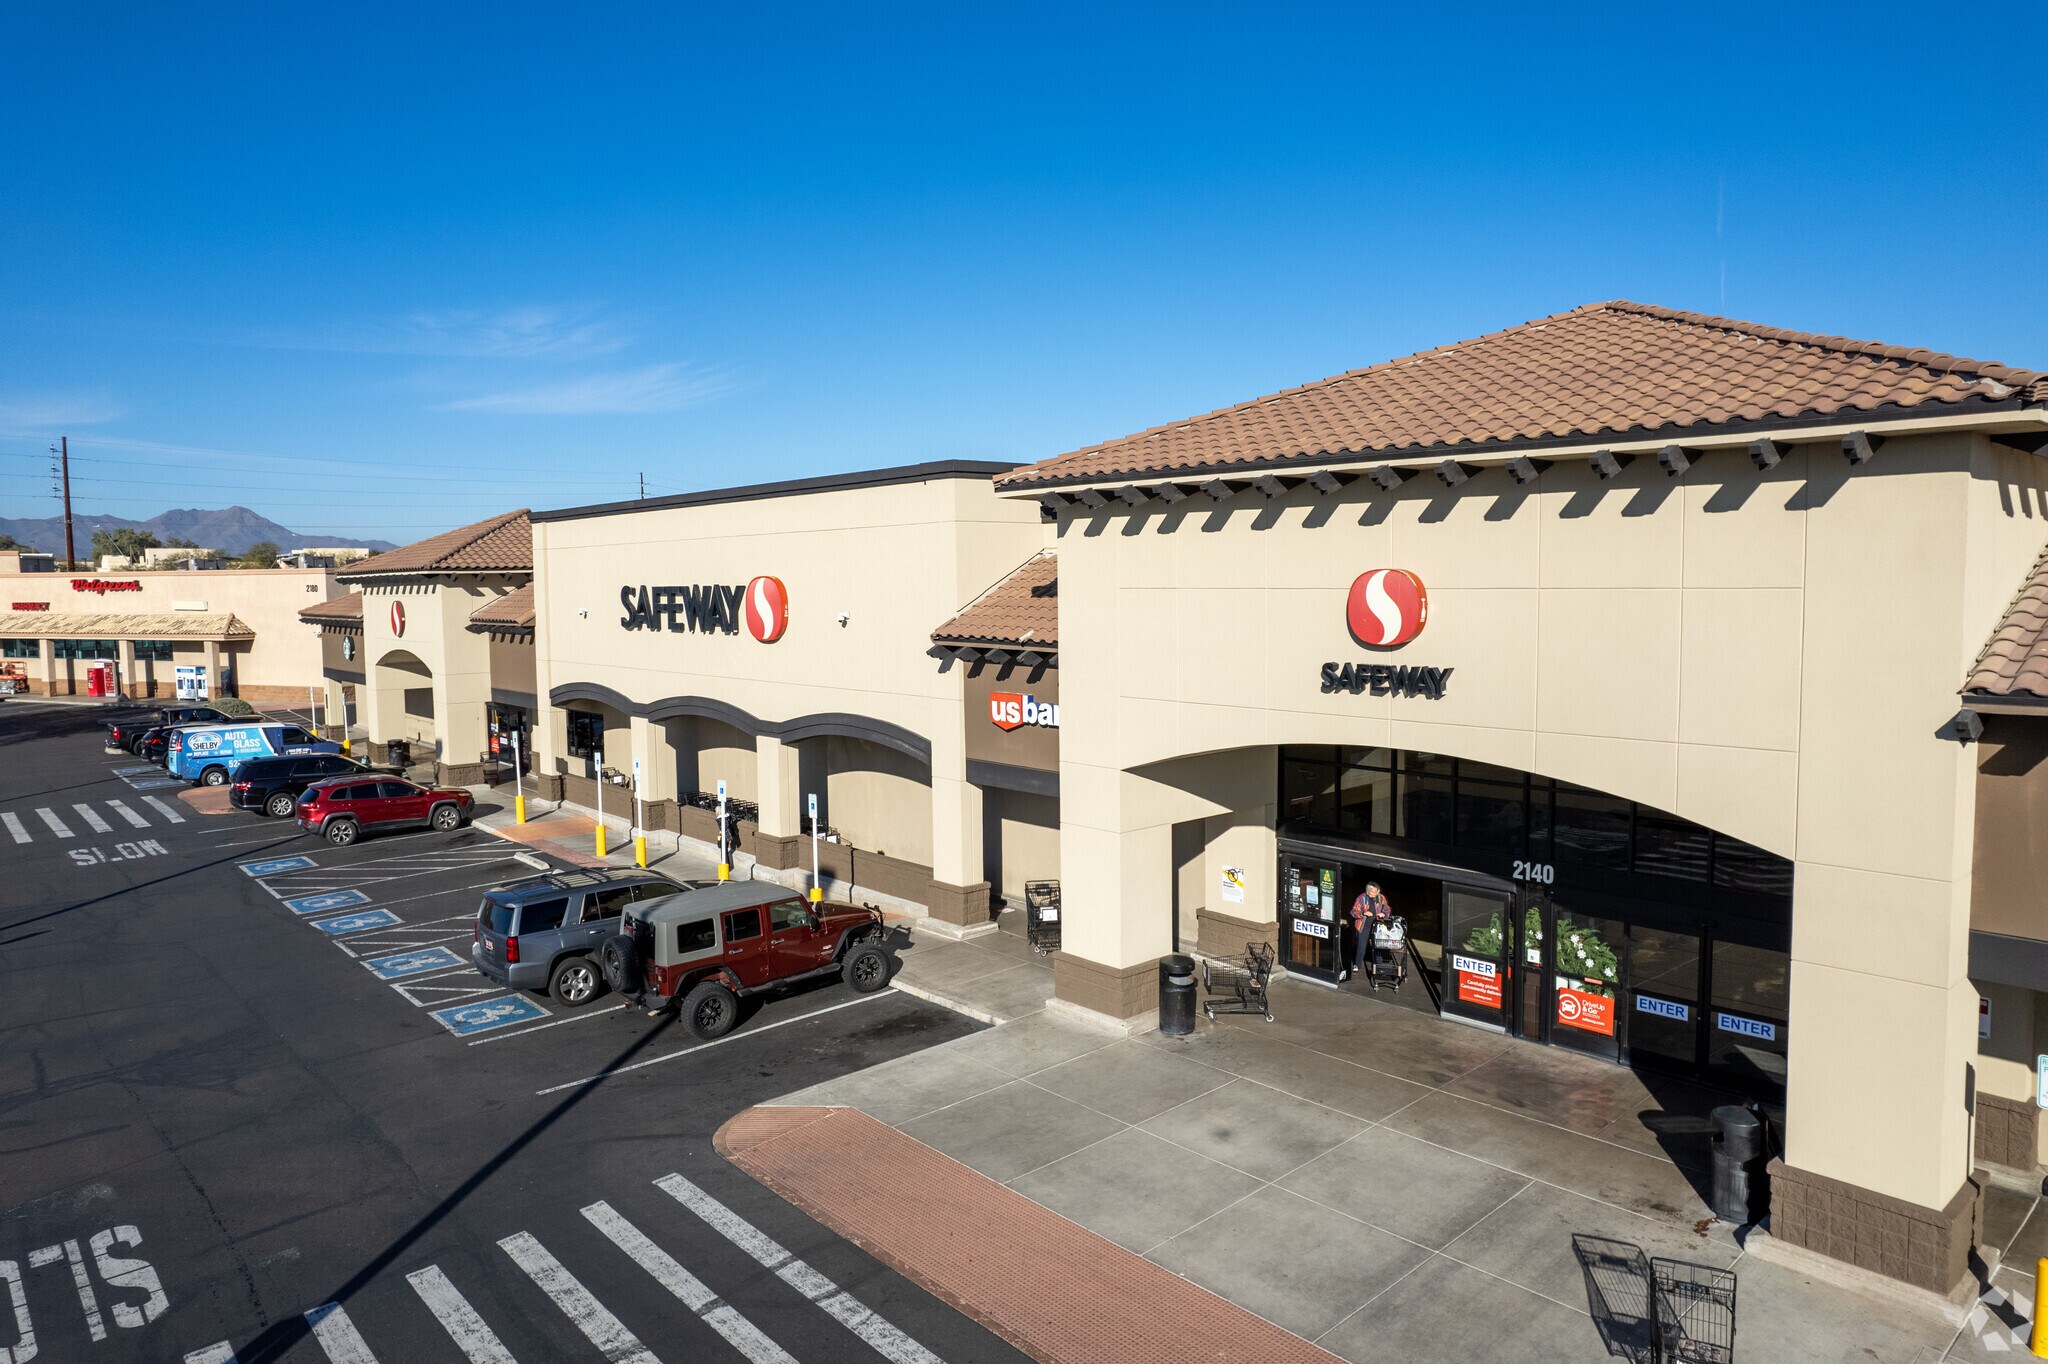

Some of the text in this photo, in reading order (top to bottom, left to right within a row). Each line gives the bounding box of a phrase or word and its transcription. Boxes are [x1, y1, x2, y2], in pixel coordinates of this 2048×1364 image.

[70, 579, 140, 595] Walgreens
[620, 584, 746, 635] SAFEWAY
[1320, 662, 1455, 701] SAFEWAY
[224, 731, 247, 741] AUTO
[233, 738, 261, 749] GLASS
[192, 741, 219, 751] SHELBY
[68, 839, 169, 866] SLOW
[1512, 860, 1554, 885] 2140
[1296, 921, 1327, 936] ENTER
[1455, 957, 1493, 975] ENTER
[1639, 998, 1685, 1018] ENTER
[1721, 1016, 1771, 1038] ENTER
